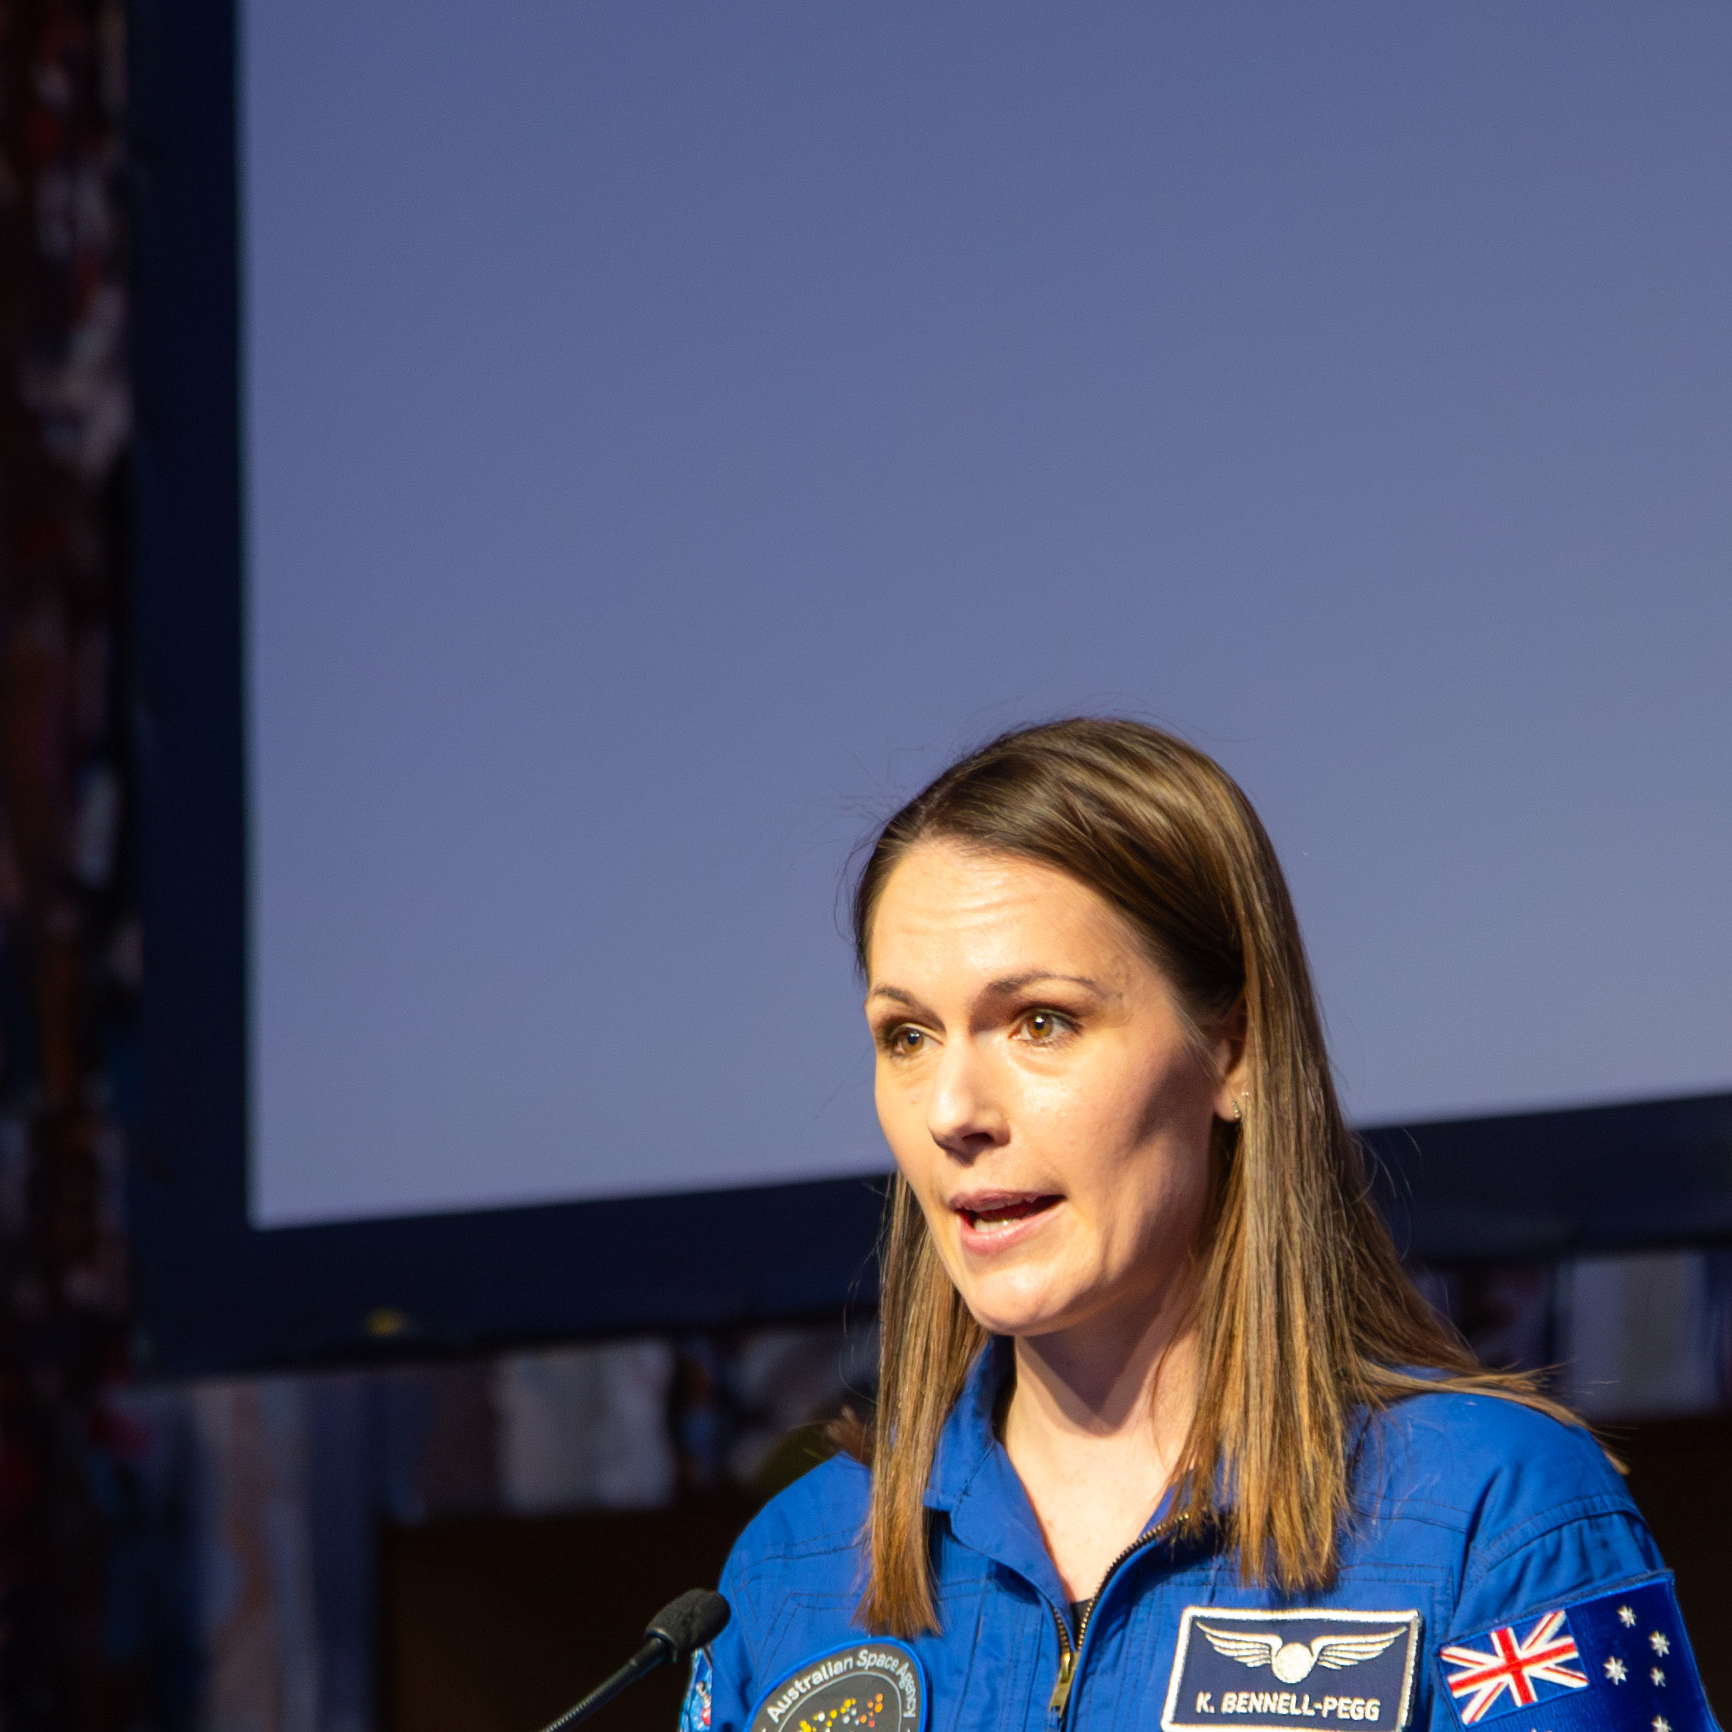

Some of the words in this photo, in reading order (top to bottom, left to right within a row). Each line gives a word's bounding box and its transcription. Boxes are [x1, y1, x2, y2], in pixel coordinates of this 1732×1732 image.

[767, 1656, 854, 1724] Australian
[856, 1649, 899, 1670] Space
[896, 1661, 917, 1718] Agency
[1195, 1690, 1215, 1714] K.
[1221, 1690, 1381, 1721] BENNELL-PEGG
